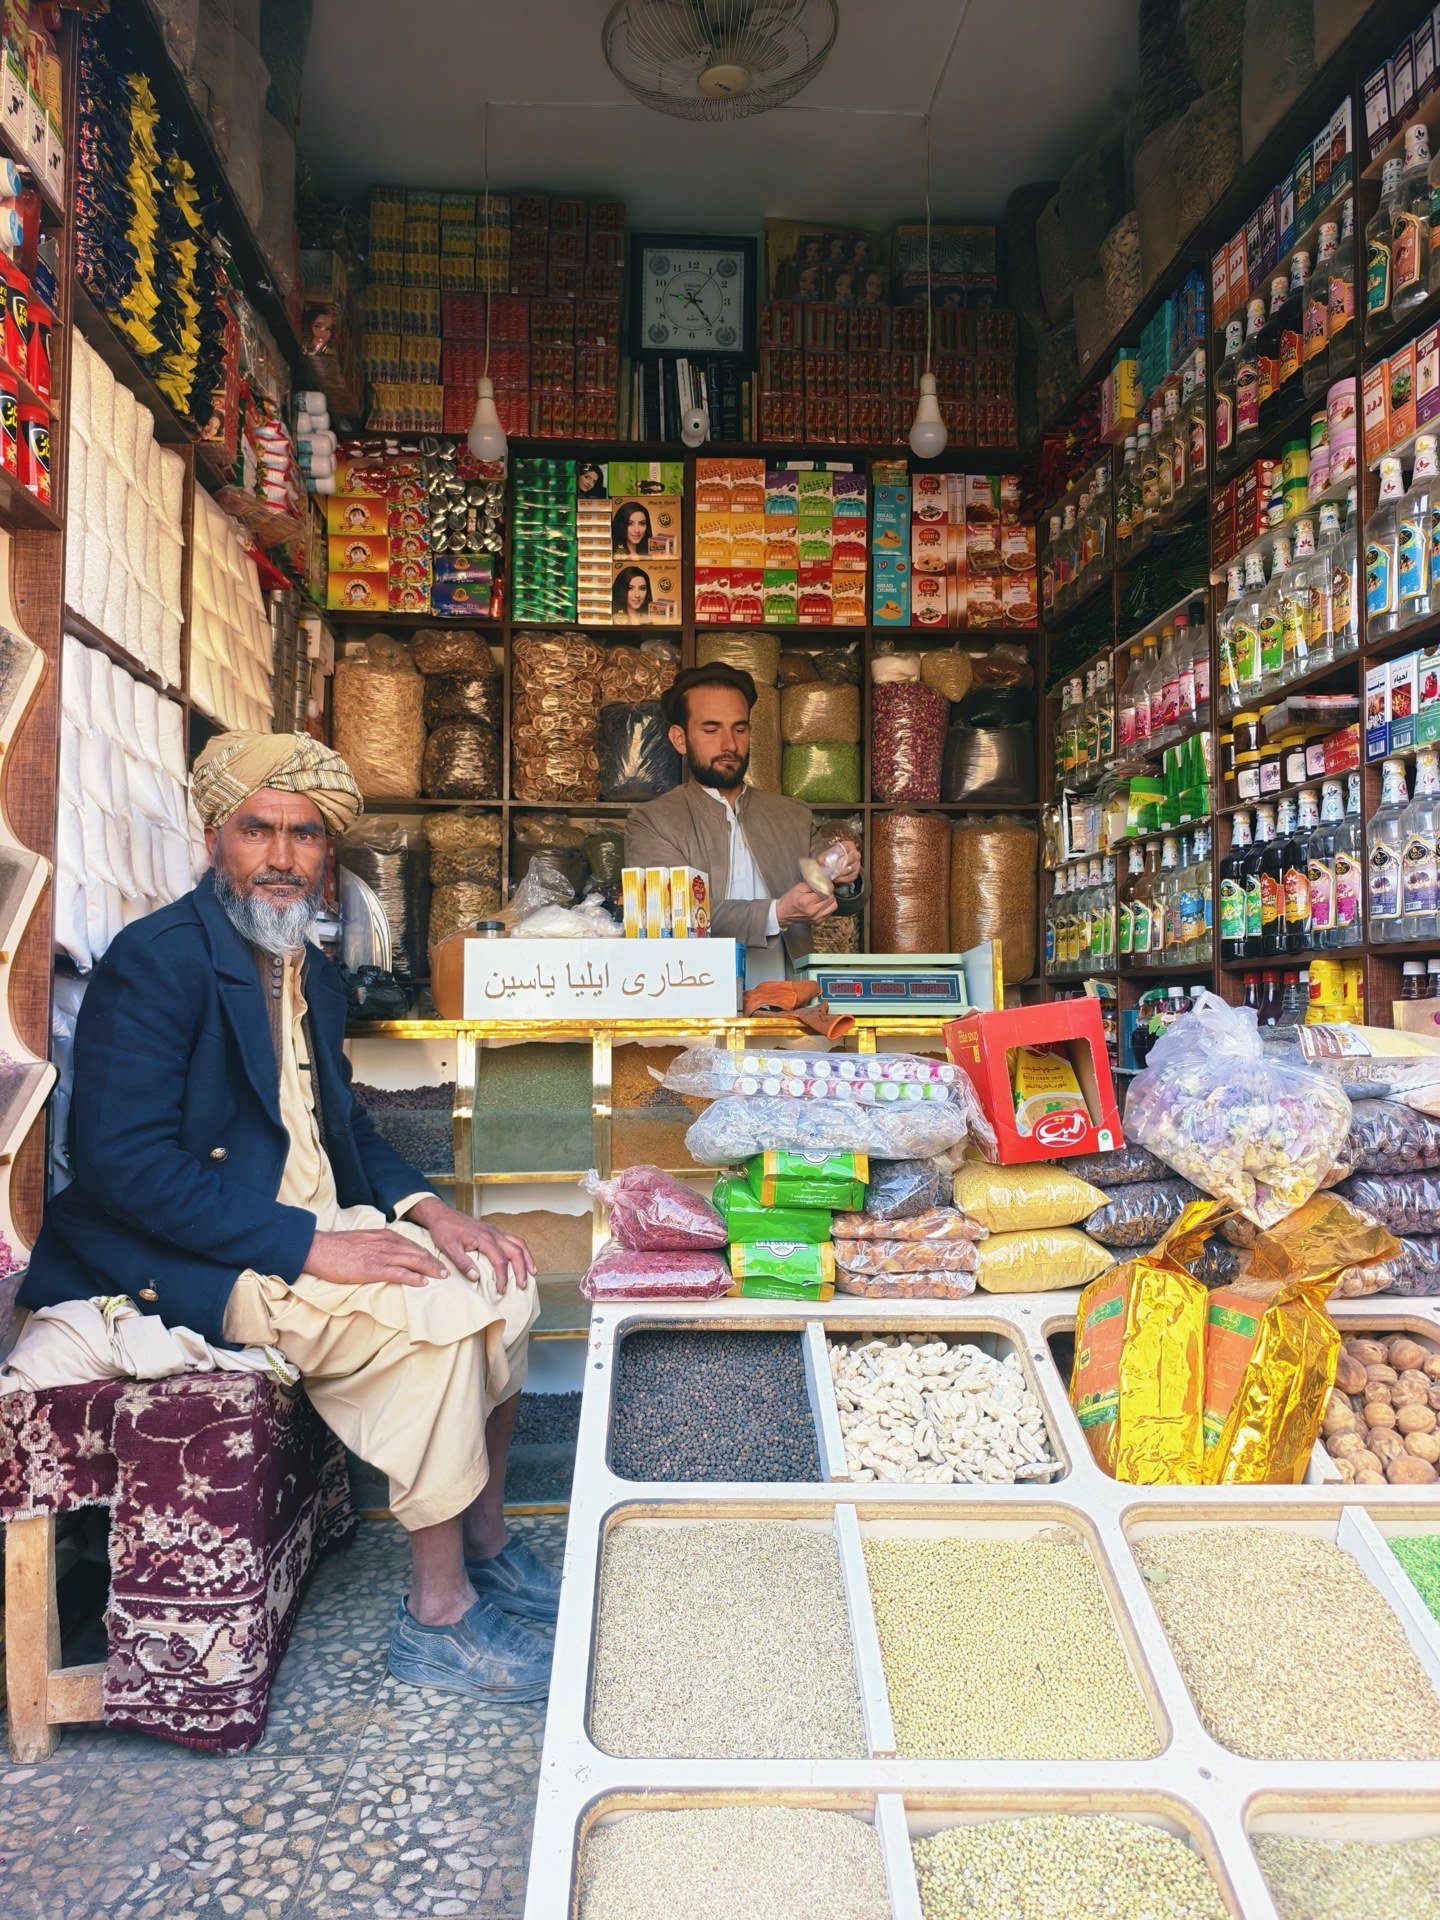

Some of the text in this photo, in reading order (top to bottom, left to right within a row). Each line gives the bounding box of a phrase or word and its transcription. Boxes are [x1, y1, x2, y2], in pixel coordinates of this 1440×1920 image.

[673, 264, 682, 272] 11
[688, 261, 700, 269] 12
[656, 279, 667, 287] 10
[721, 280, 728, 288] 2
[656, 297, 662, 305] 9
[724, 298, 731, 306] 3
[660, 312, 666, 320] 8
[718, 316, 724, 324] 4
[673, 327, 679, 335] 7
[706, 328, 712, 336] 5
[689, 332, 695, 340] 6
[484, 960, 715, 999] عطاری ایلیا یاسین
